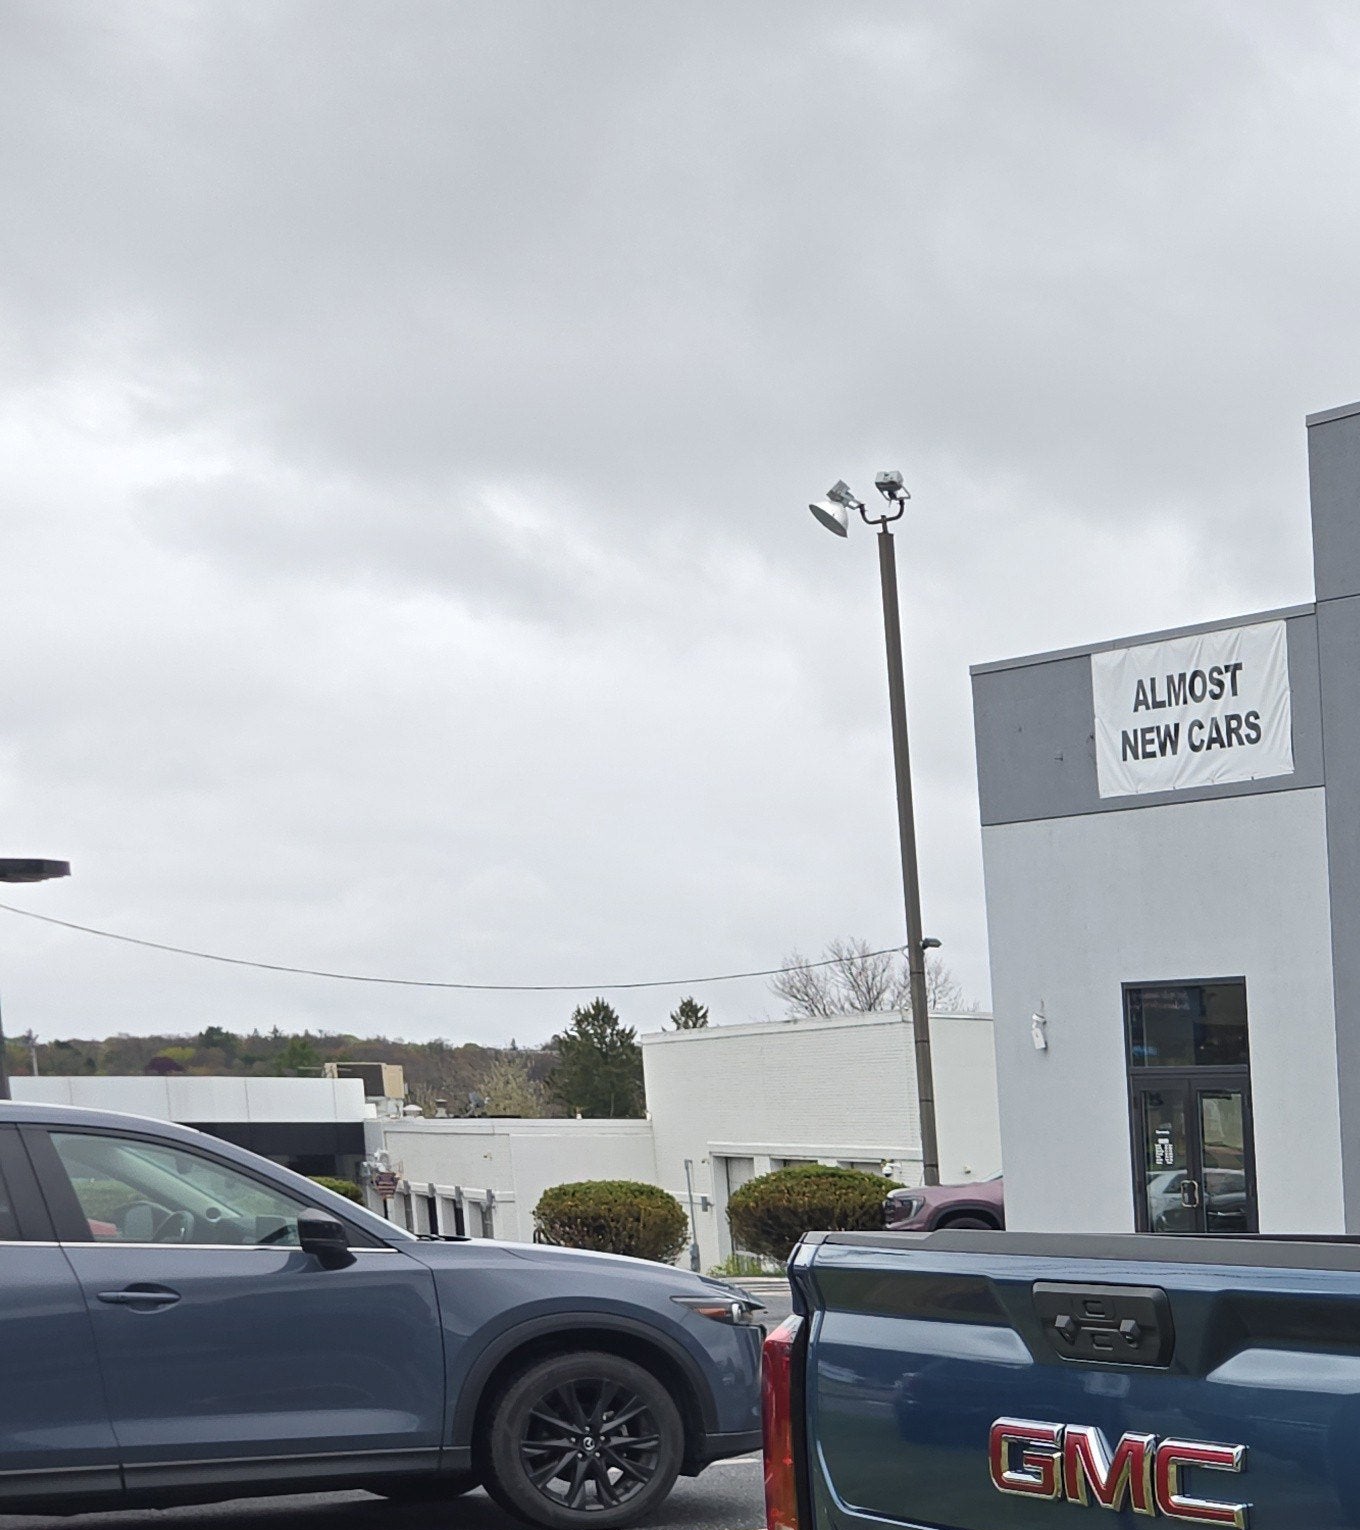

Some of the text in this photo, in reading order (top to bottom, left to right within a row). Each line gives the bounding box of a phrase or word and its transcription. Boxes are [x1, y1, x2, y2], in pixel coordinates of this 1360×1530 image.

[1133, 662, 1243, 713] ALMOST
[1121, 710, 1262, 762] NEW CARS
[988, 1416, 1254, 1530] GMC
